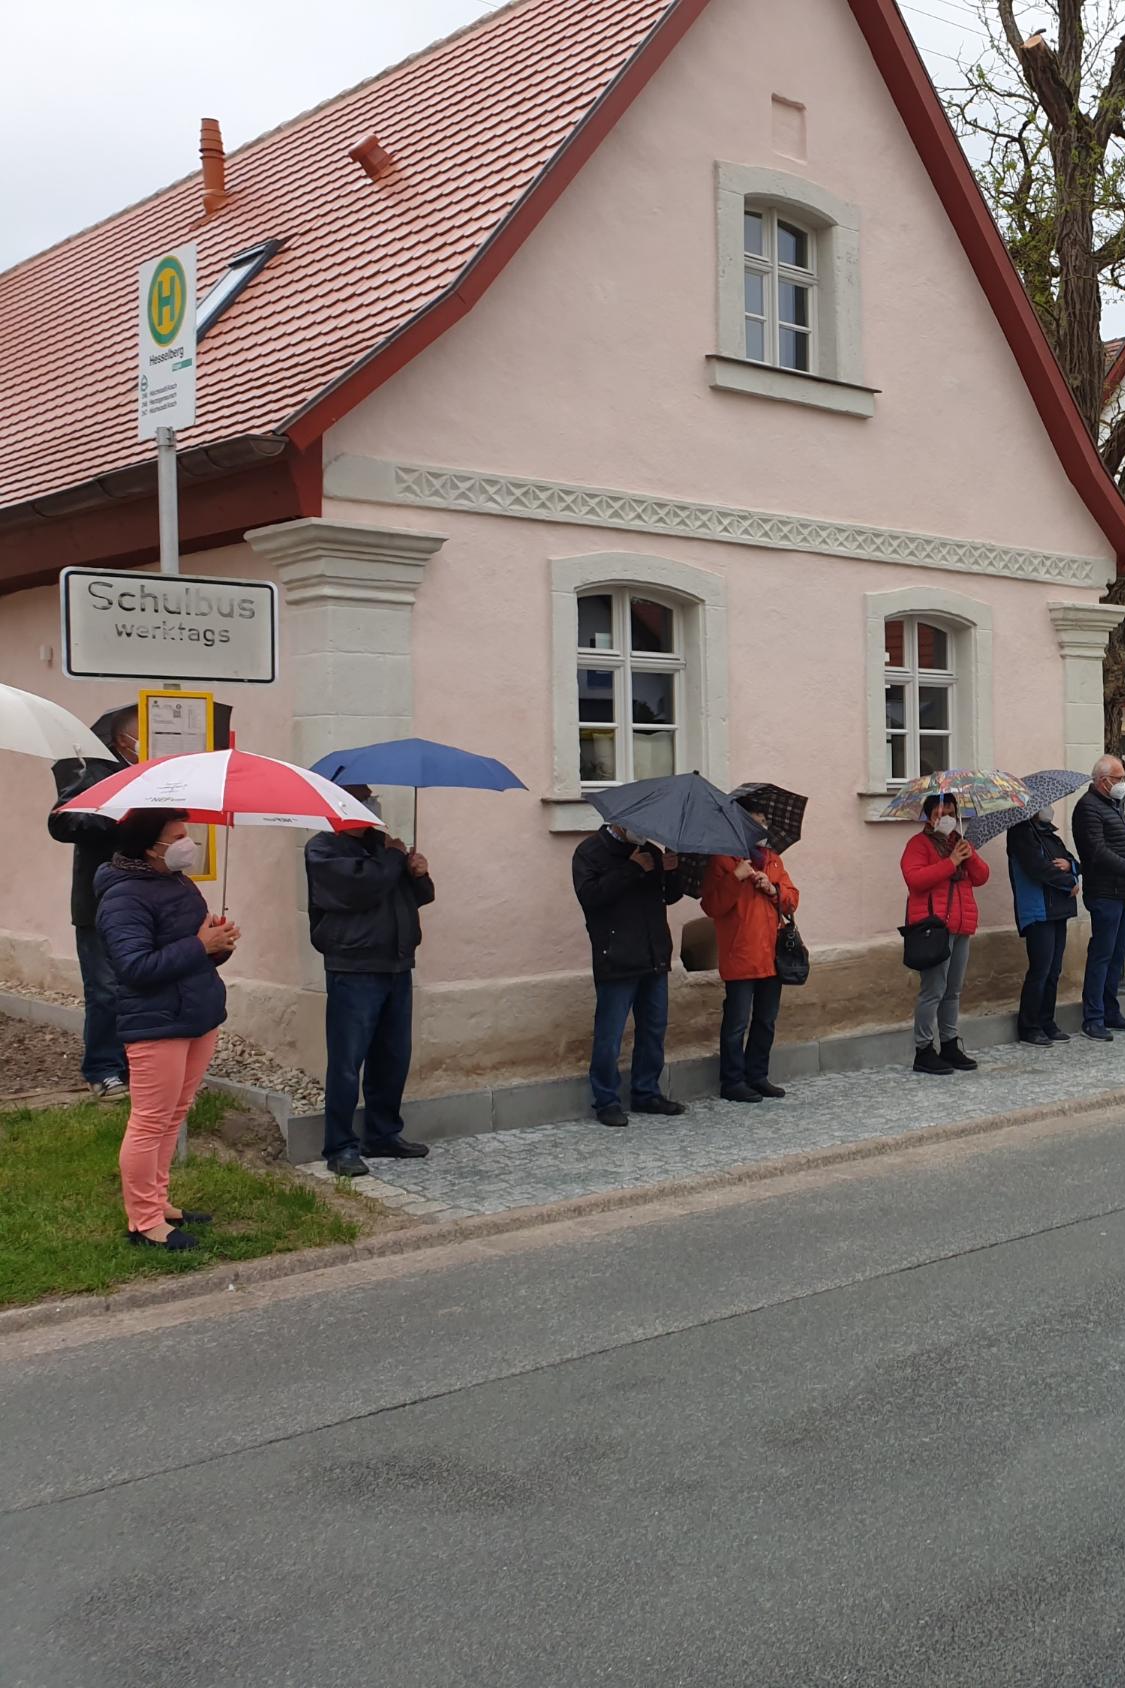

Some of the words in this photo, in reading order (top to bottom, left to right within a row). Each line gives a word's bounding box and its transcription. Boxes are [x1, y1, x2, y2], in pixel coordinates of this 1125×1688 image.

[158, 275, 175, 327] H
[149, 347, 184, 366] Hesselberg
[88, 581, 256, 619] Schulbus
[115, 621, 230, 647] werktags
